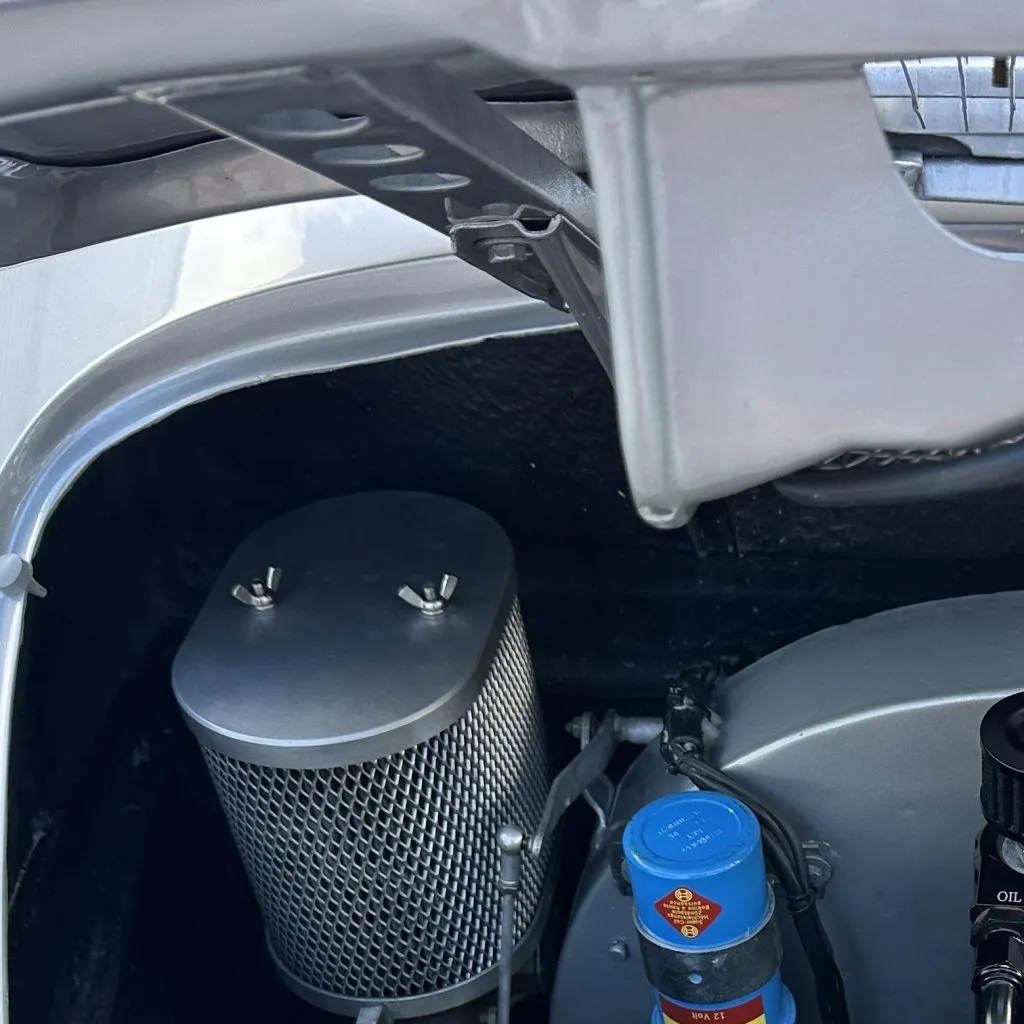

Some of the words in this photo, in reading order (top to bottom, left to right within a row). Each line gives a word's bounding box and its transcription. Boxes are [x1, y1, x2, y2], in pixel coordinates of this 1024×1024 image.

[996, 891, 1022, 903] OIL
[691, 1011, 711, 1020] Volt
[712, 1011, 726, 1020] 12
